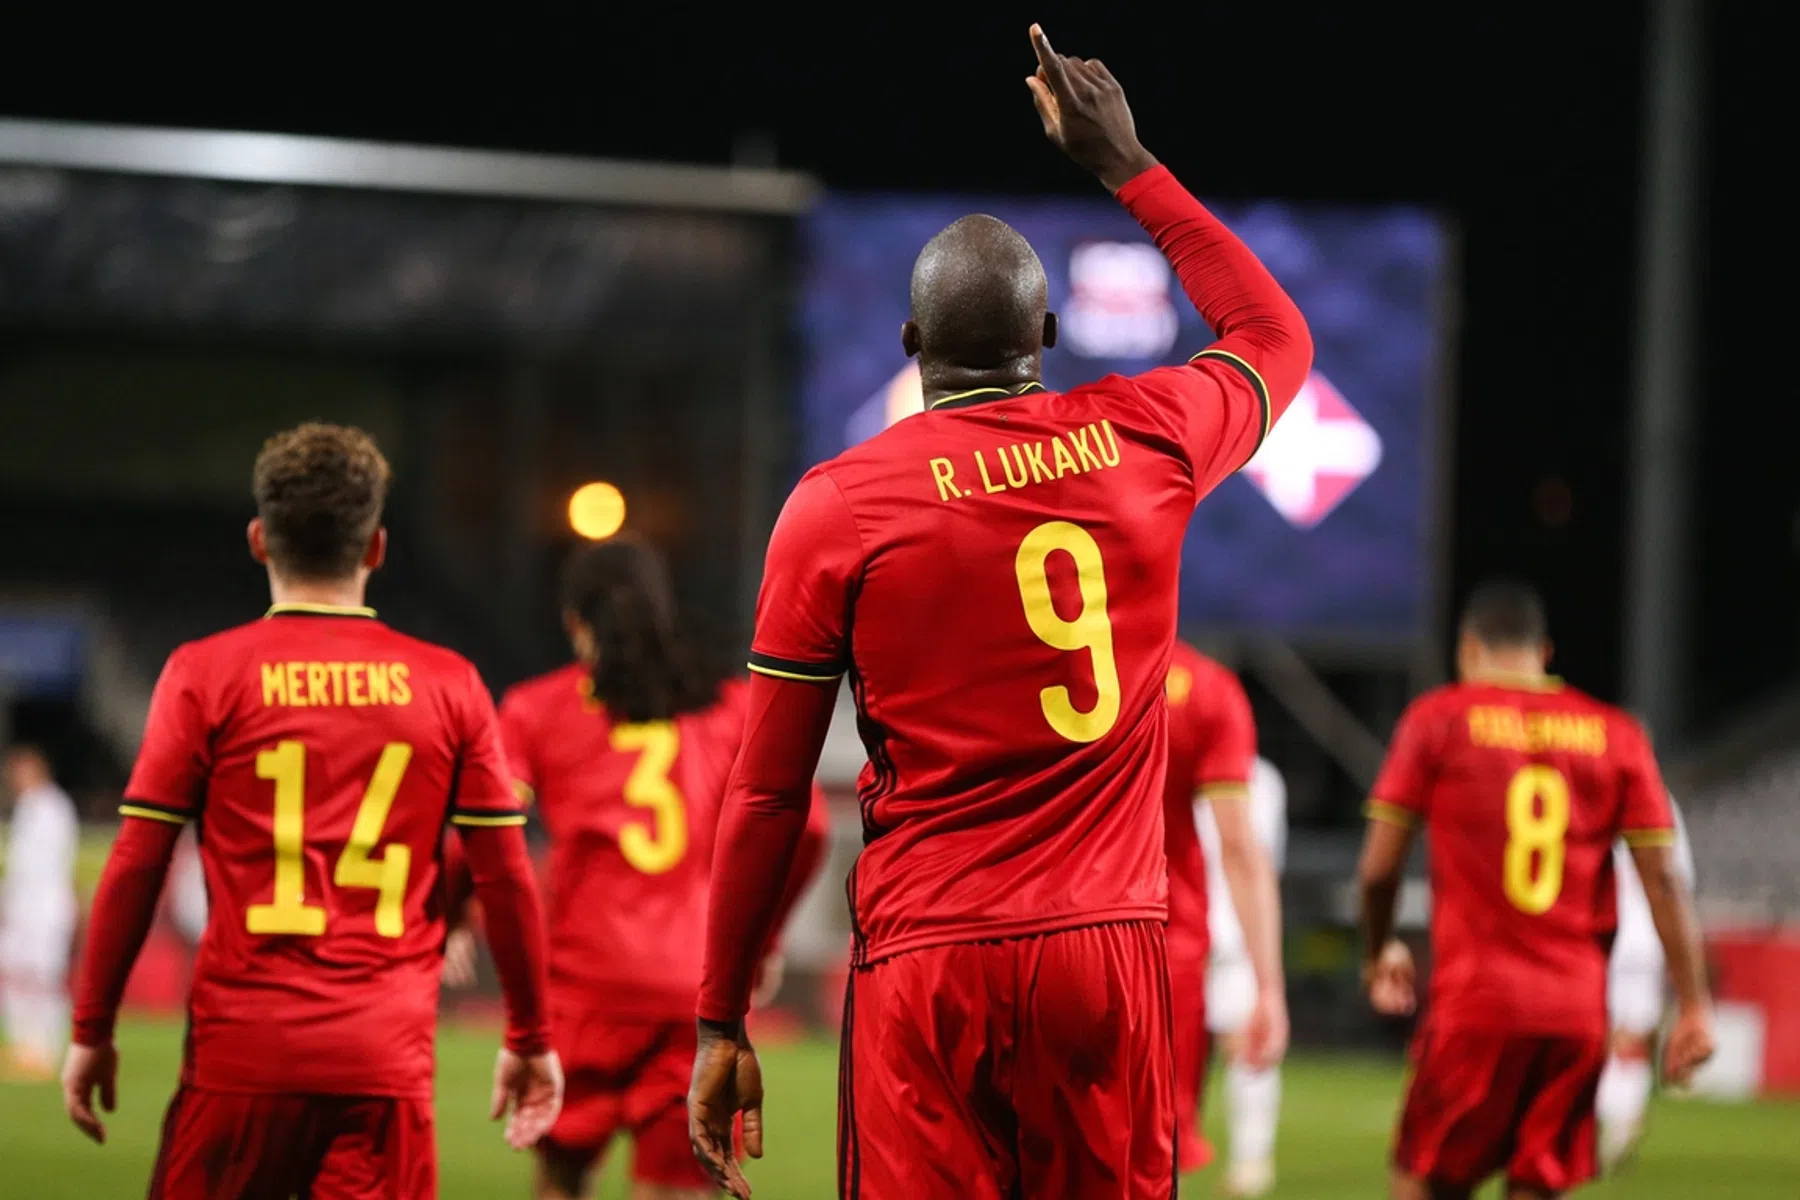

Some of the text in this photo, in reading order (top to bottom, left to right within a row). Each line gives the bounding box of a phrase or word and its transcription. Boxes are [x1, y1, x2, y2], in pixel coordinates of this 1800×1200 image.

[930, 419, 1120, 501] R. LUKAKU
[261, 662, 411, 706] MERTENS
[1015, 520, 1121, 743] 9
[246, 741, 411, 937] 14
[611, 721, 687, 873] 3
[1504, 765, 1569, 913] 8
